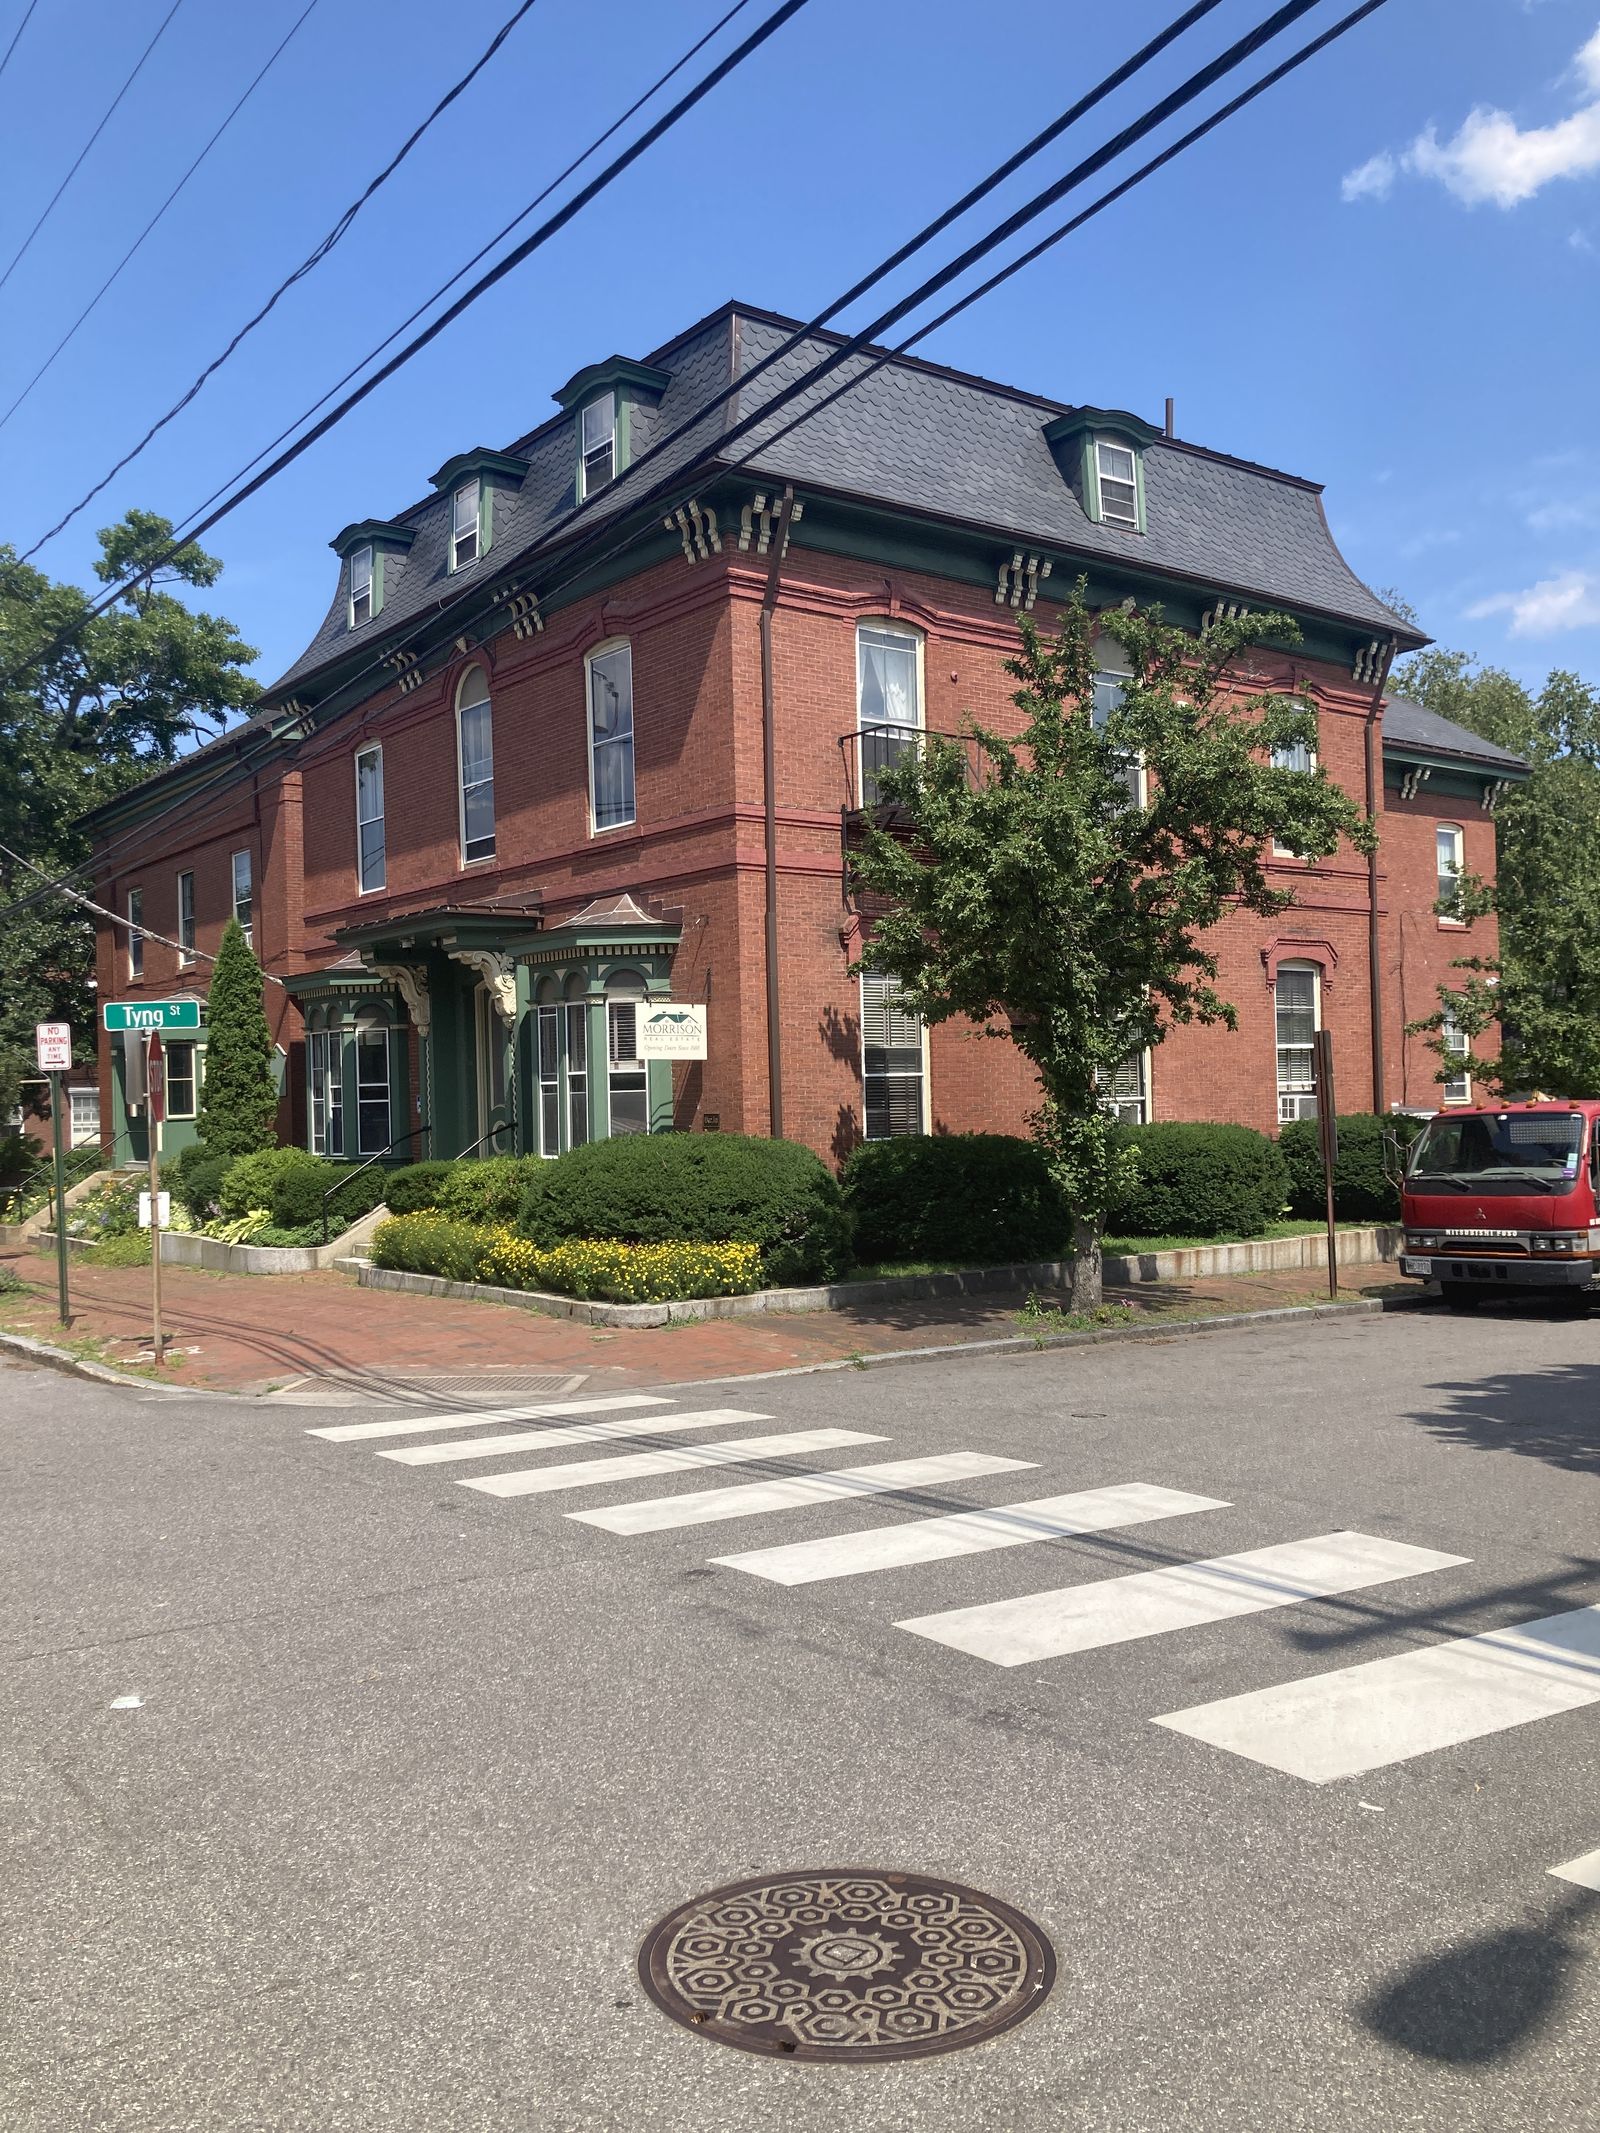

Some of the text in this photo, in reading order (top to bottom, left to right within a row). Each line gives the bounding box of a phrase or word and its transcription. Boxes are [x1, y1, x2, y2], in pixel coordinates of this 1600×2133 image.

[123, 1005, 181, 1027] Tyng St
[47, 1027, 60, 1035] NO
[643, 1024, 702, 1034] MORRISON
[40, 1036, 68, 1045] PARKING
[1445, 1229, 1494, 1237] MITSUBISHI
